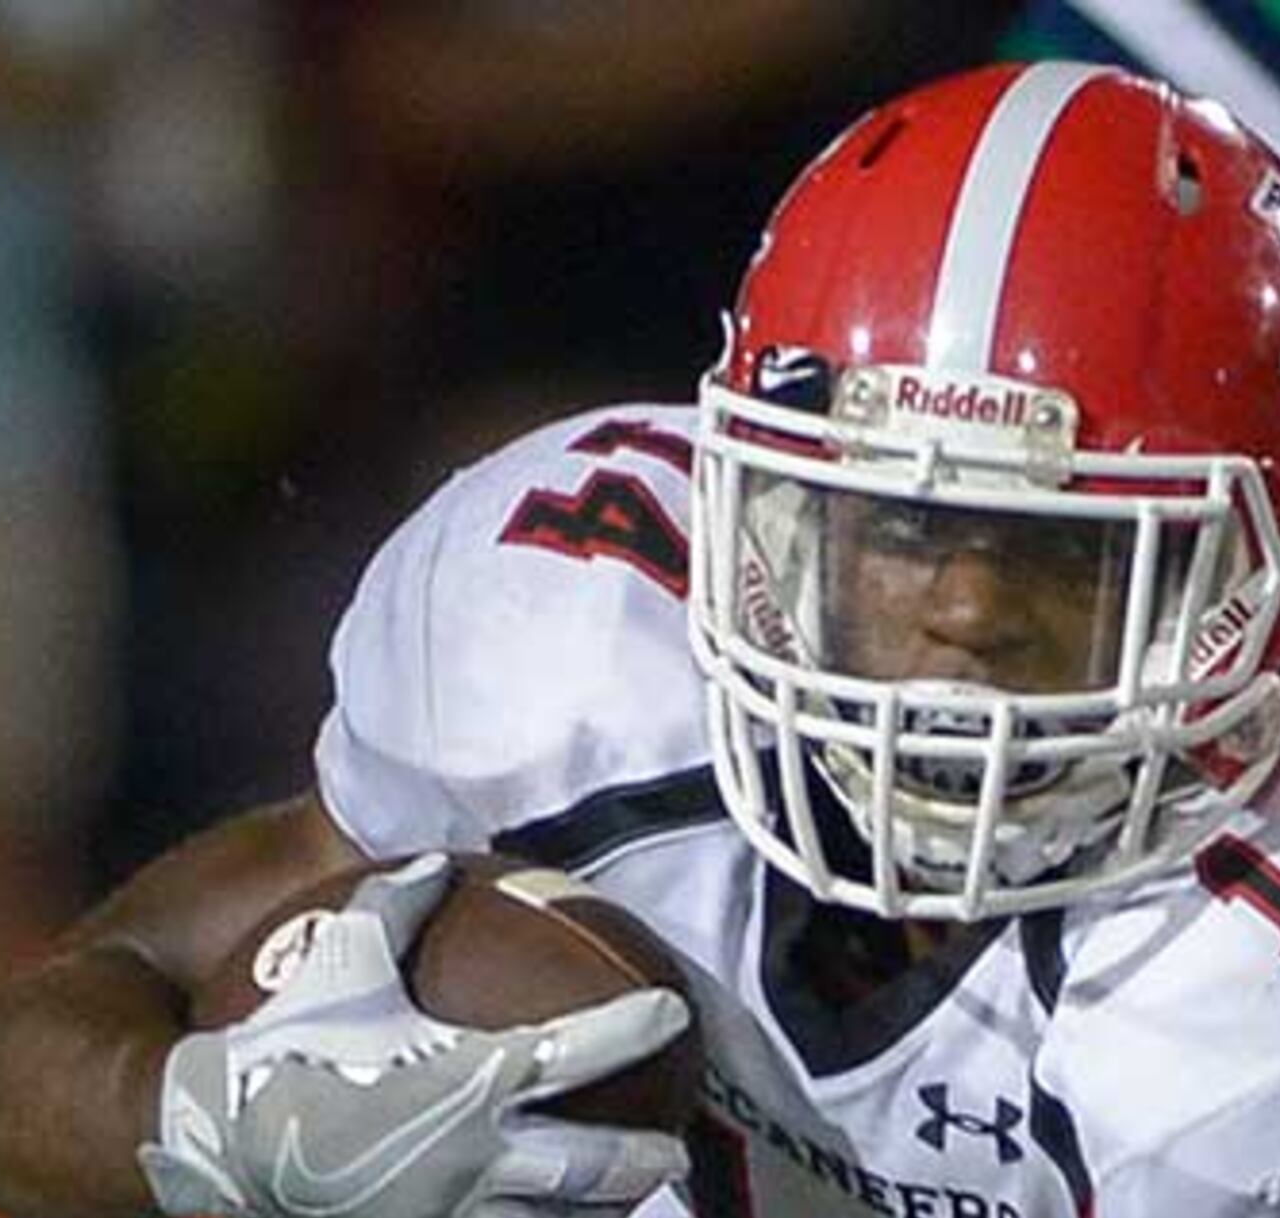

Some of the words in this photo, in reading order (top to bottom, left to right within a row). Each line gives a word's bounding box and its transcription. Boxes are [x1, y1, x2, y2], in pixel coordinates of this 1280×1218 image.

[896, 375, 1027, 428] Riddell
[496, 417, 695, 603] 14
[745, 558, 801, 668] Ridde
